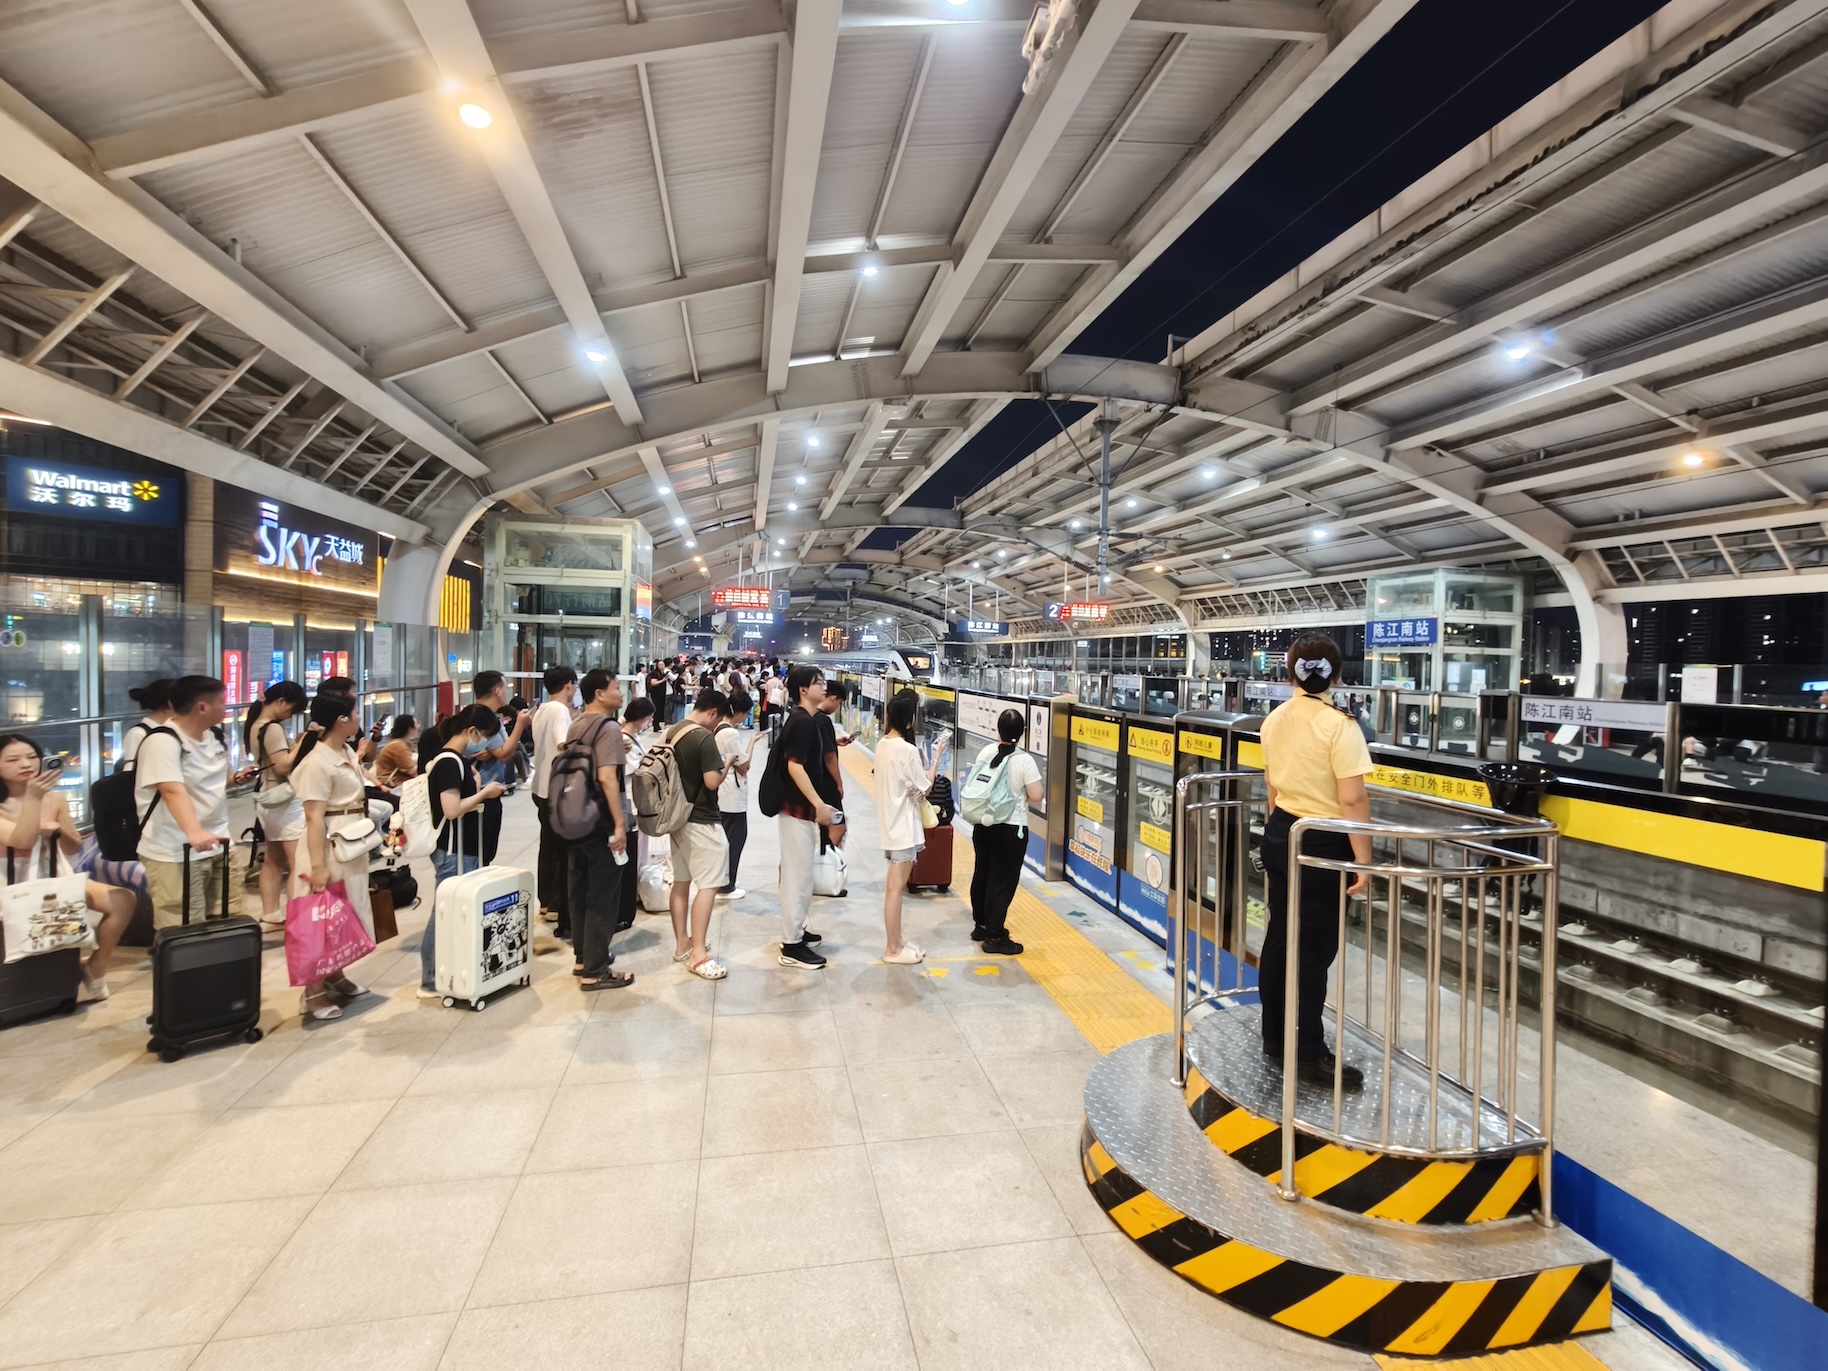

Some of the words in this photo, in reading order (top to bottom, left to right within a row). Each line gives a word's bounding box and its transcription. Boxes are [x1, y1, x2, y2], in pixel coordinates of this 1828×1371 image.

[29, 468, 132, 496] Walmart
[30, 486, 134, 512] 沃尔玛
[324, 533, 364, 566] 天益城
[776, 593, 783, 607] 1
[1048, 604, 1059, 618] 2
[1373, 620, 1430, 638] 陈江南站
[1524, 702, 1593, 722] 陈江南站
